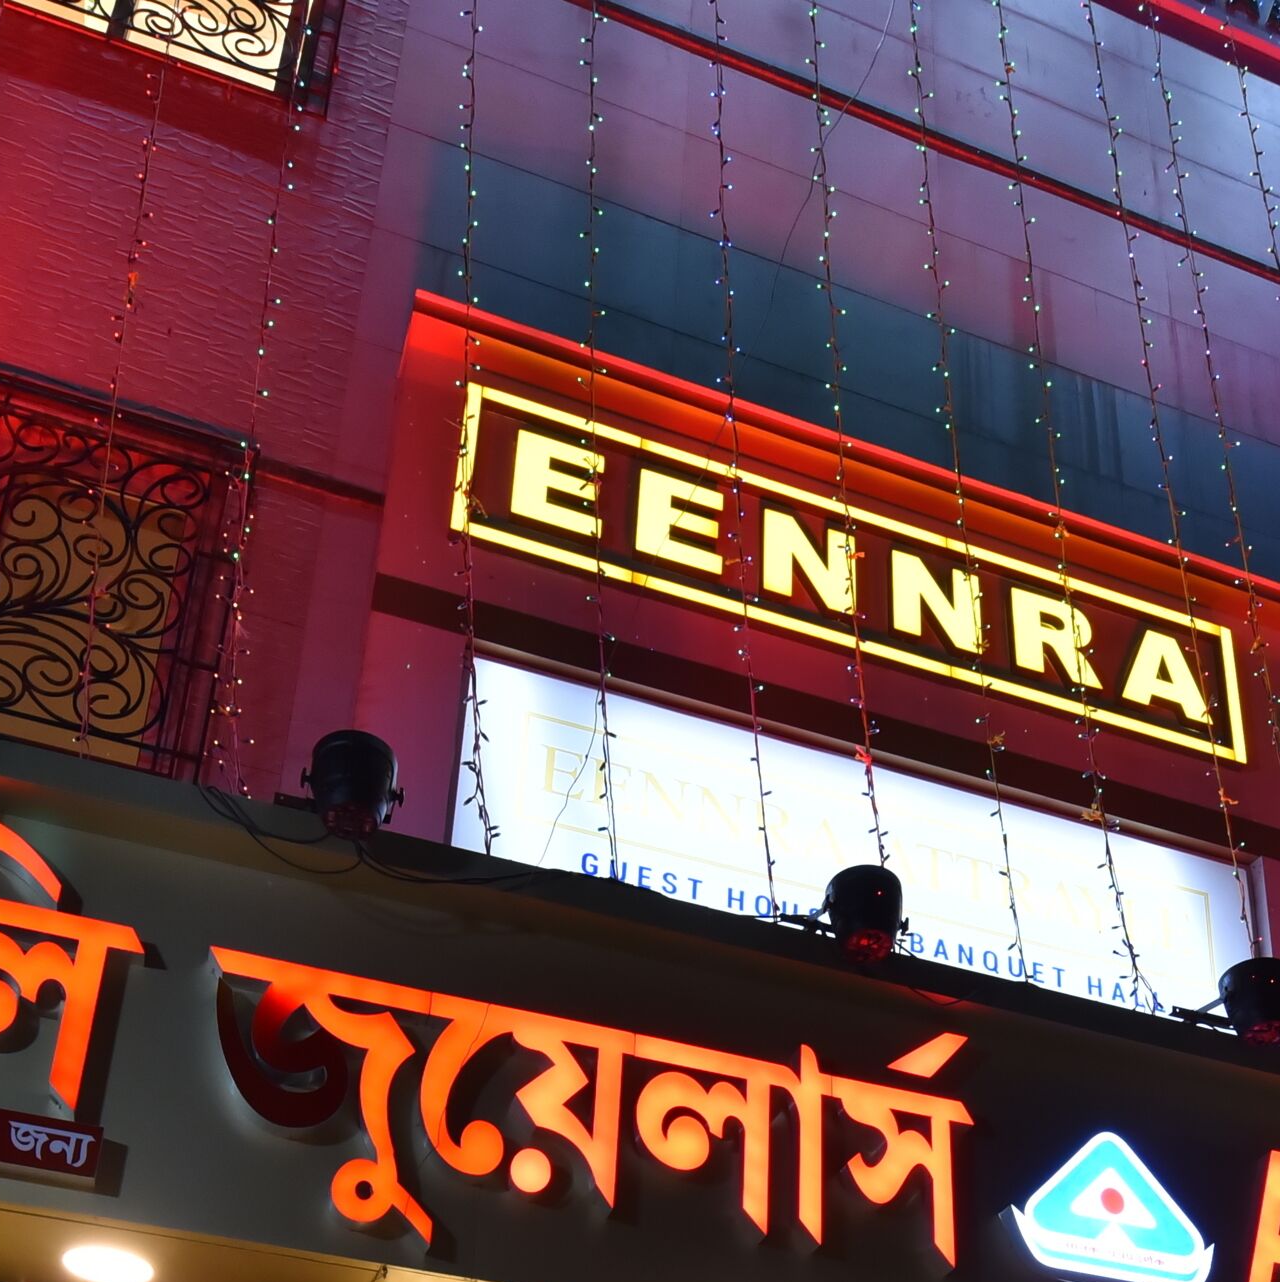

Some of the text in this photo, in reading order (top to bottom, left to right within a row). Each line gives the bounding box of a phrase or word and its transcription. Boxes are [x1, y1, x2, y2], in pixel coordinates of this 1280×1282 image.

[509, 429, 1215, 725] EENNRA
[581, 853, 703, 899] GUEST
[909, 932, 1065, 988] BANQUET
[9, 1120, 96, 1168] জন্য
[209, 946, 974, 1269] জুয়েলার্স
